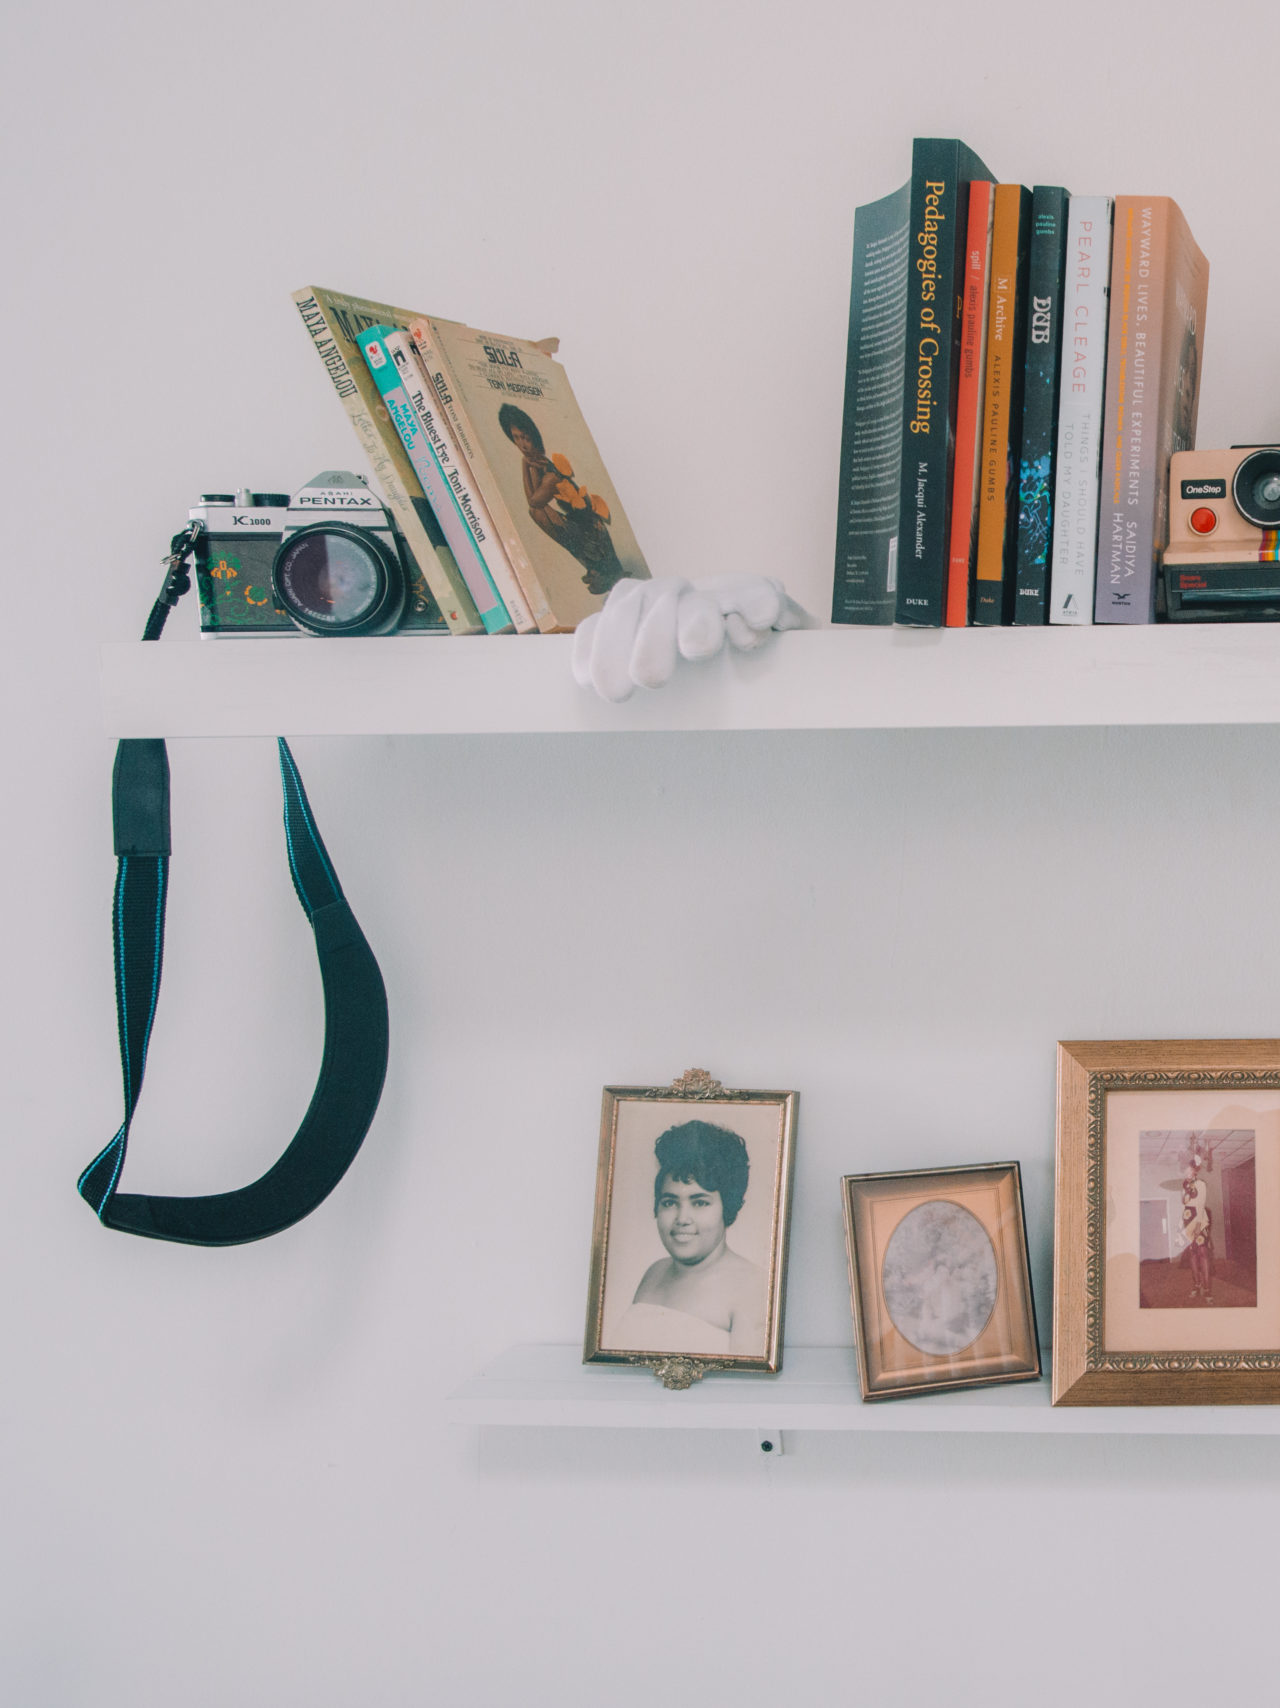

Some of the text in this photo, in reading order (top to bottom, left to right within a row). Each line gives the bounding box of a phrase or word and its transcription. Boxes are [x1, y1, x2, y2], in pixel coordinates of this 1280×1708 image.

[970, 250, 981, 270] spill
[1137, 207, 1153, 279] WAYWARD
[909, 180, 946, 434] Pedagogies of Crossing
[968, 285, 979, 310] alexis
[994, 277, 1009, 341] M Archive
[1031, 295, 1052, 344] DUB
[1072, 220, 1093, 393] PEARL CLEAGE
[296, 296, 358, 399] MAYA ANGELOU
[965, 313, 978, 345] pauline
[483, 345, 523, 369] SULA
[963, 348, 976, 378] gumbs
[1131, 332, 1146, 406] BEAUTIFUL
[432, 372, 454, 405] SULA
[487, 378, 507, 391] TONI
[506, 382, 545, 398] MORRISON
[386, 399, 416, 451] ANGELOU
[400, 403, 419, 436] MAYA
[986, 355, 1003, 502] ALEXIS PAULINE GUMBS
[1079, 413, 1091, 464] THINGS
[412, 390, 426, 412] The
[420, 410, 442, 444] Bluest
[435, 443, 451, 464] Eye
[447, 468, 465, 498] Toni
[458, 493, 487, 544] Morrison
[1127, 411, 1143, 505] EXPERIMENTS
[300, 497, 372, 506] PENTAX
[912, 461, 929, 559] M. Jacqui Alexander
[1059, 423, 1074, 565] TOLD MY DAUGHTER
[1076, 487, 1087, 535] SHOULD
[1186, 485, 1222, 494] OneStep
[1074, 541, 1085, 576] HAVE
[1110, 512, 1124, 584] HARTMAN
[1123, 521, 1138, 578] SAIDIYA
[906, 598, 929, 606] DUKE
[1019, 588, 1039, 596] DUKE
[1179, 581, 1207, 589] Special
